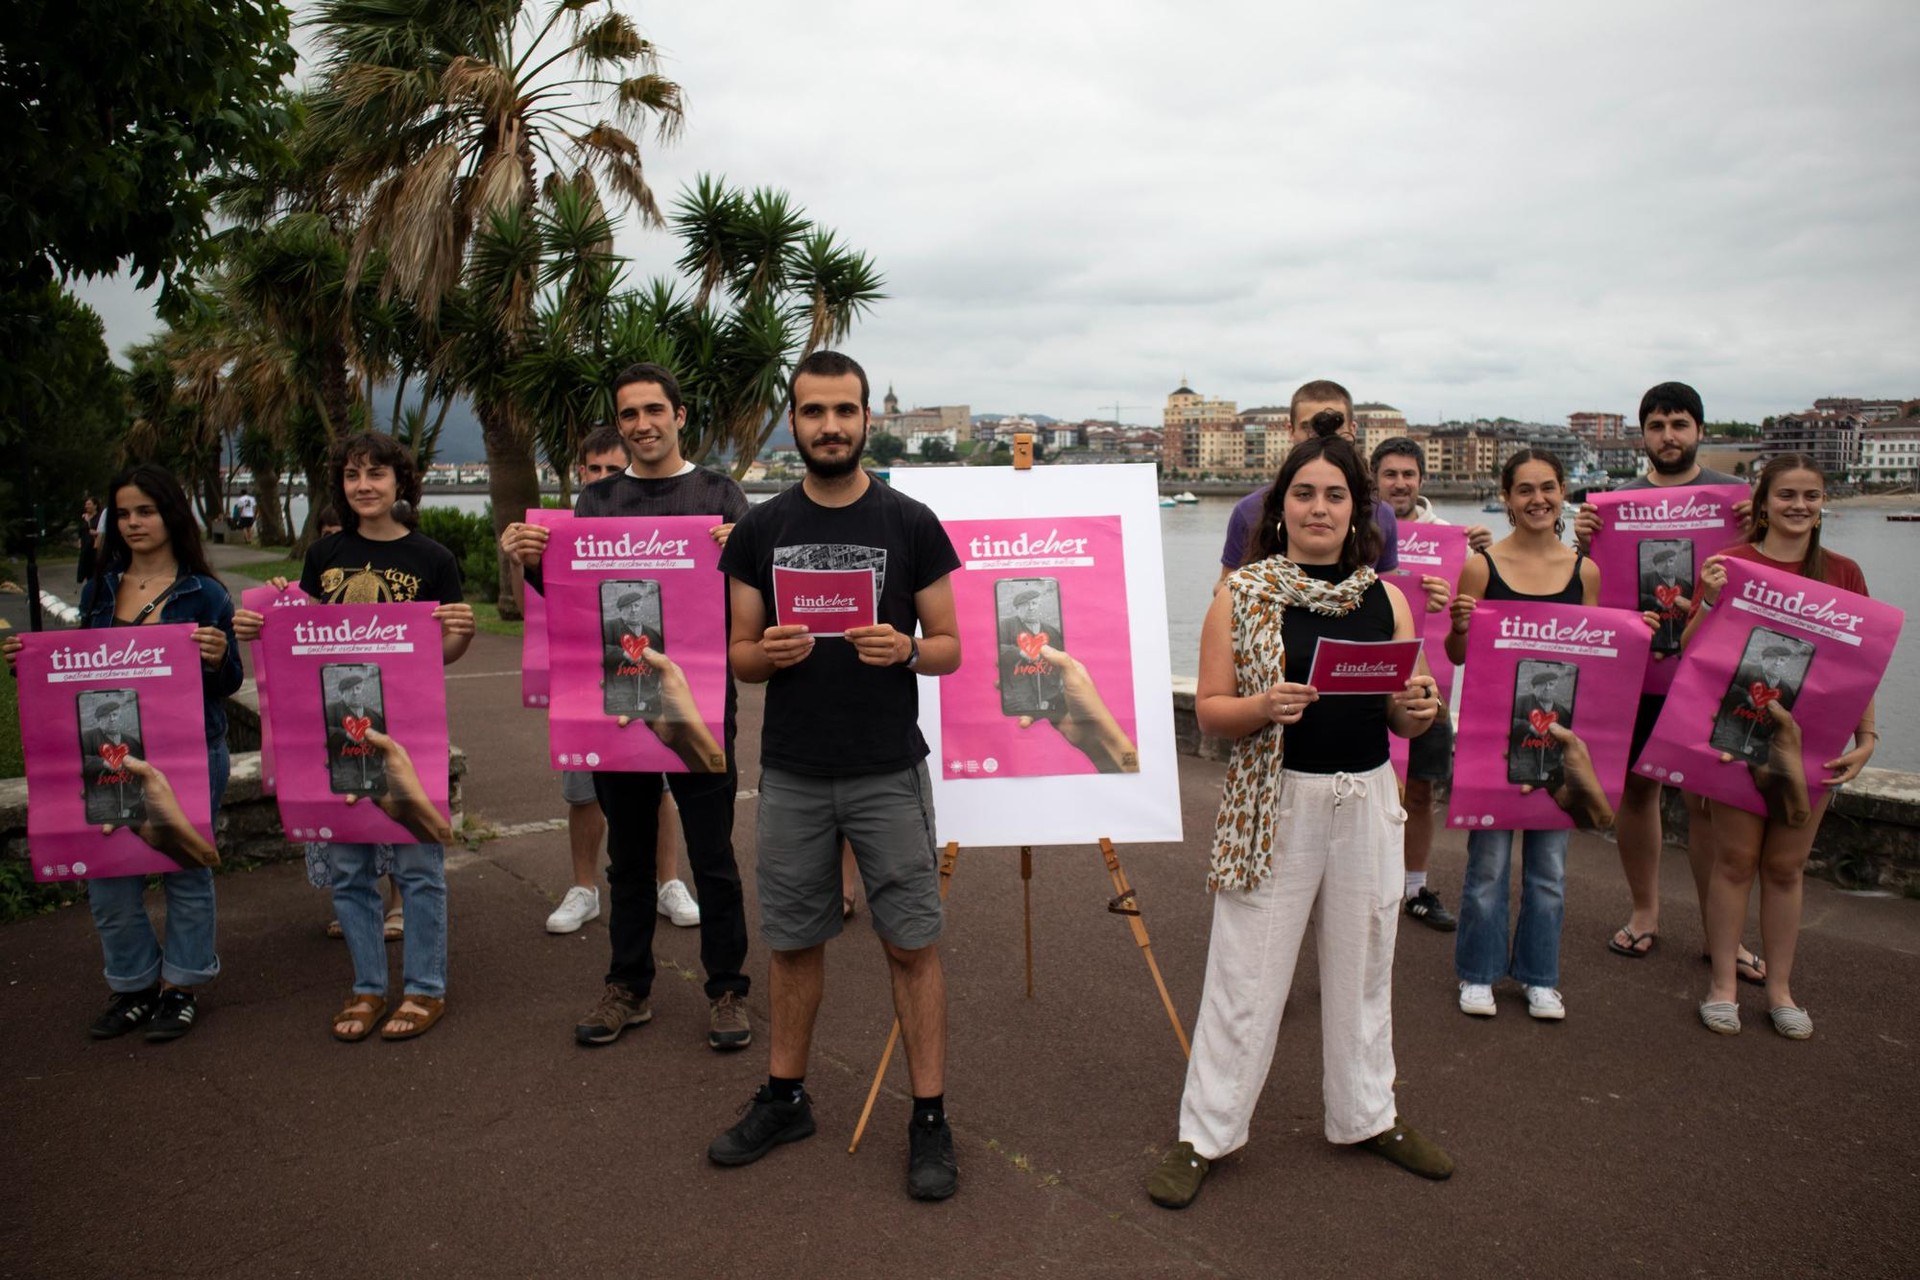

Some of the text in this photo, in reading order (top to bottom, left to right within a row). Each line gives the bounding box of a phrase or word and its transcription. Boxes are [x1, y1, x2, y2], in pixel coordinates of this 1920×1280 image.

[1617, 495, 1721, 521] tindeher
[574, 529, 689, 558] tindeher
[969, 528, 1088, 558] tindeher
[1398, 531, 1439, 555] eher
[794, 593, 856, 607] tindeher
[1742, 578, 1864, 632] tindeher
[294, 615, 408, 643] tindeher
[1500, 616, 1616, 645] tindeher
[50, 638, 165, 670] tindeher
[1335, 660, 1397, 673] tindeher
